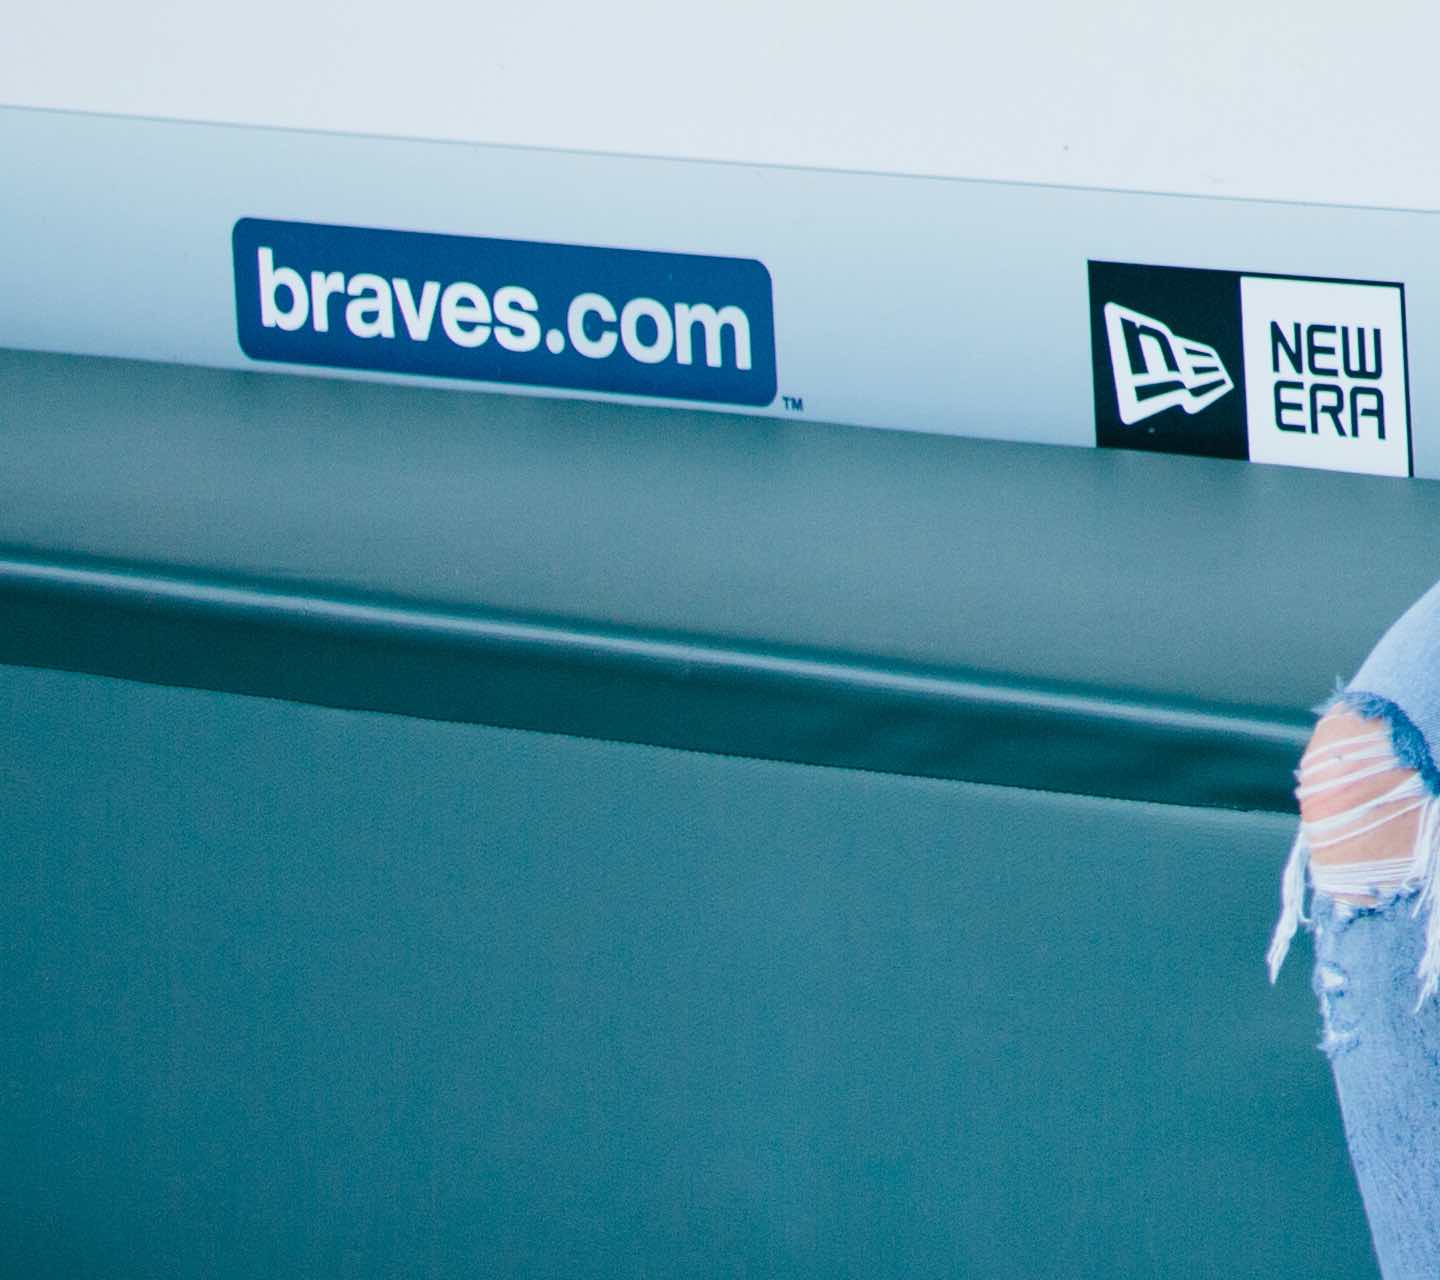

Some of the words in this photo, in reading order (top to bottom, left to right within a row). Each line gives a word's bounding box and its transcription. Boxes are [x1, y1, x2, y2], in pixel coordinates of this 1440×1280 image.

[257, 247, 753, 372] braves.com
[1270, 320, 1383, 381] NEW
[782, 395, 804, 412] TM
[1273, 382, 1386, 442] ERA
